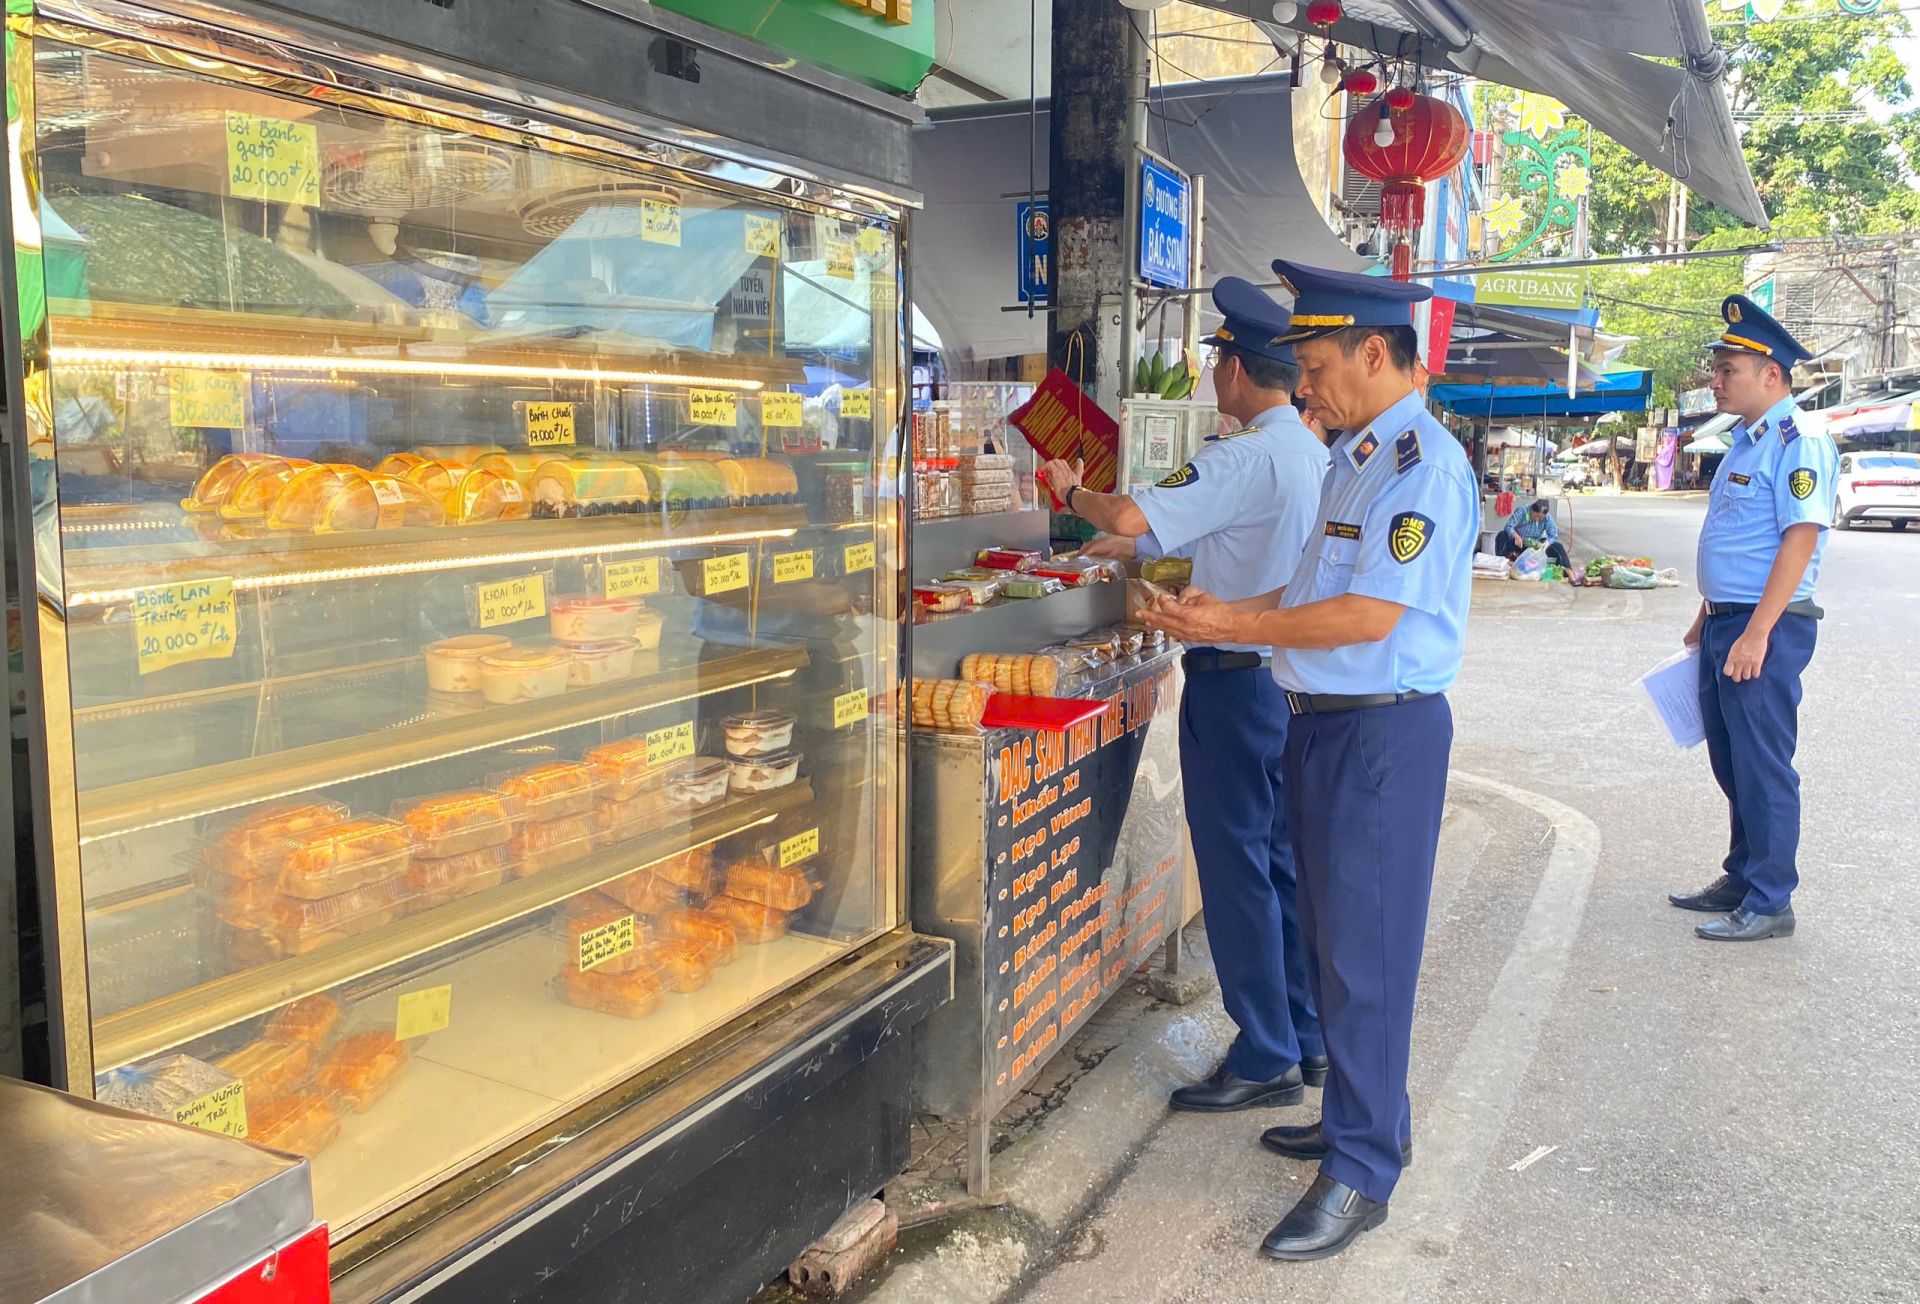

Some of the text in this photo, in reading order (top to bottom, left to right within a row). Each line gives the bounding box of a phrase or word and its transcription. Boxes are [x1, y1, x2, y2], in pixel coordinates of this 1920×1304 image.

[1155, 186, 1178, 220] ĐƯỜNG
[1148, 217, 1175, 267] BẮC
[740, 271, 763, 293] TUYỂN
[1480, 277, 1579, 298] AGRIBANK
[733, 297, 755, 316] NHÂN
[1402, 517, 1425, 530] DMS
[136, 585, 210, 608] BÔNG LAN
[483, 588, 508, 604] KHOAI
[1012, 827, 1047, 864] Kẹo
[1013, 836, 1081, 901] Kẹo Lạc
[1013, 896, 1047, 936] Kẹo
[1014, 920, 1057, 972] Bánh
[1013, 954, 1057, 1009] Bánh
[1013, 989, 1057, 1045] Bánh
[1012, 1023, 1057, 1080] Bánh
[176, 1101, 206, 1122] BÁNH
